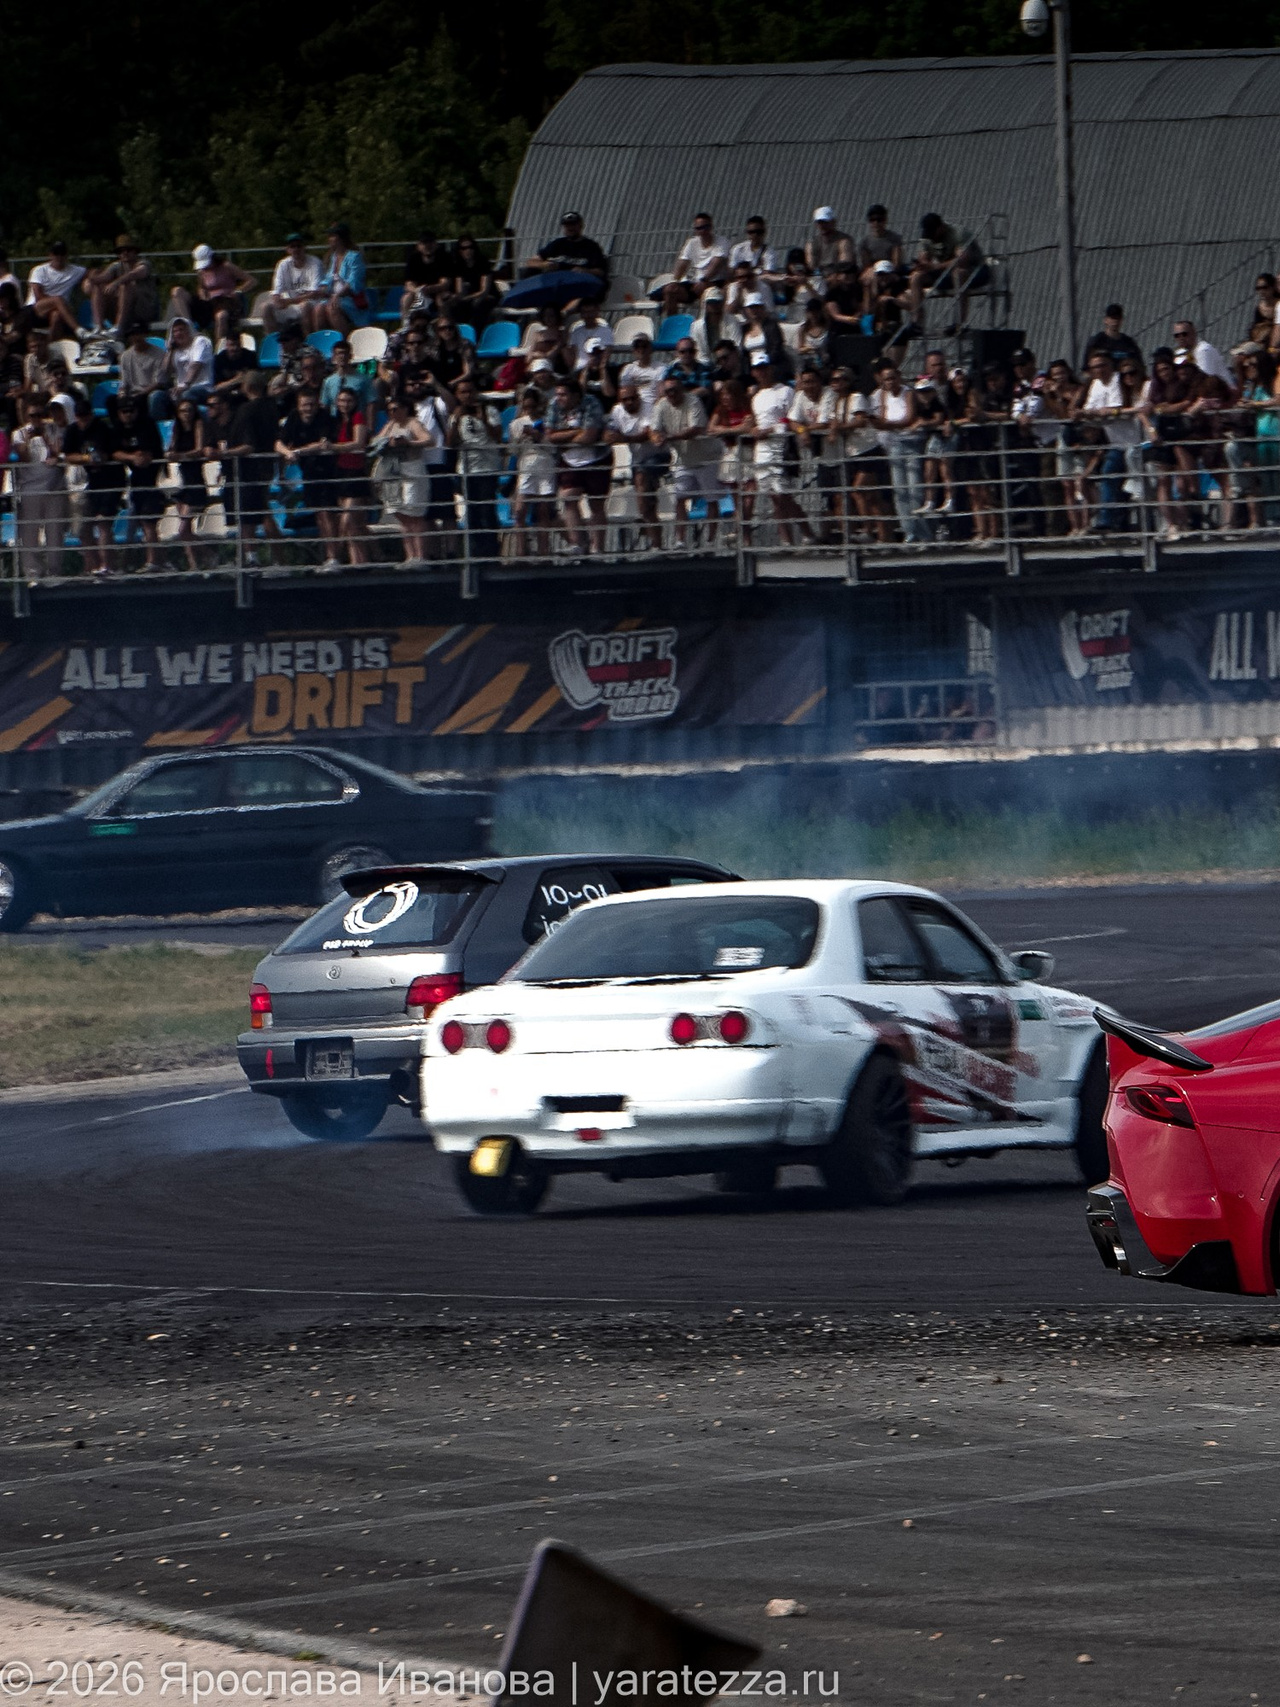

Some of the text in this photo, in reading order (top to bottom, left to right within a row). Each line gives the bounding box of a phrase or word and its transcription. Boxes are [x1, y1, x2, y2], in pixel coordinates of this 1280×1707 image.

[588, 635, 672, 666] DRIFT
[1080, 608, 1131, 640] DRIFT
[1209, 612, 1257, 681] ALL
[60, 638, 389, 691] ALL WE NEED IS
[252, 666, 426, 734] DRIFT
